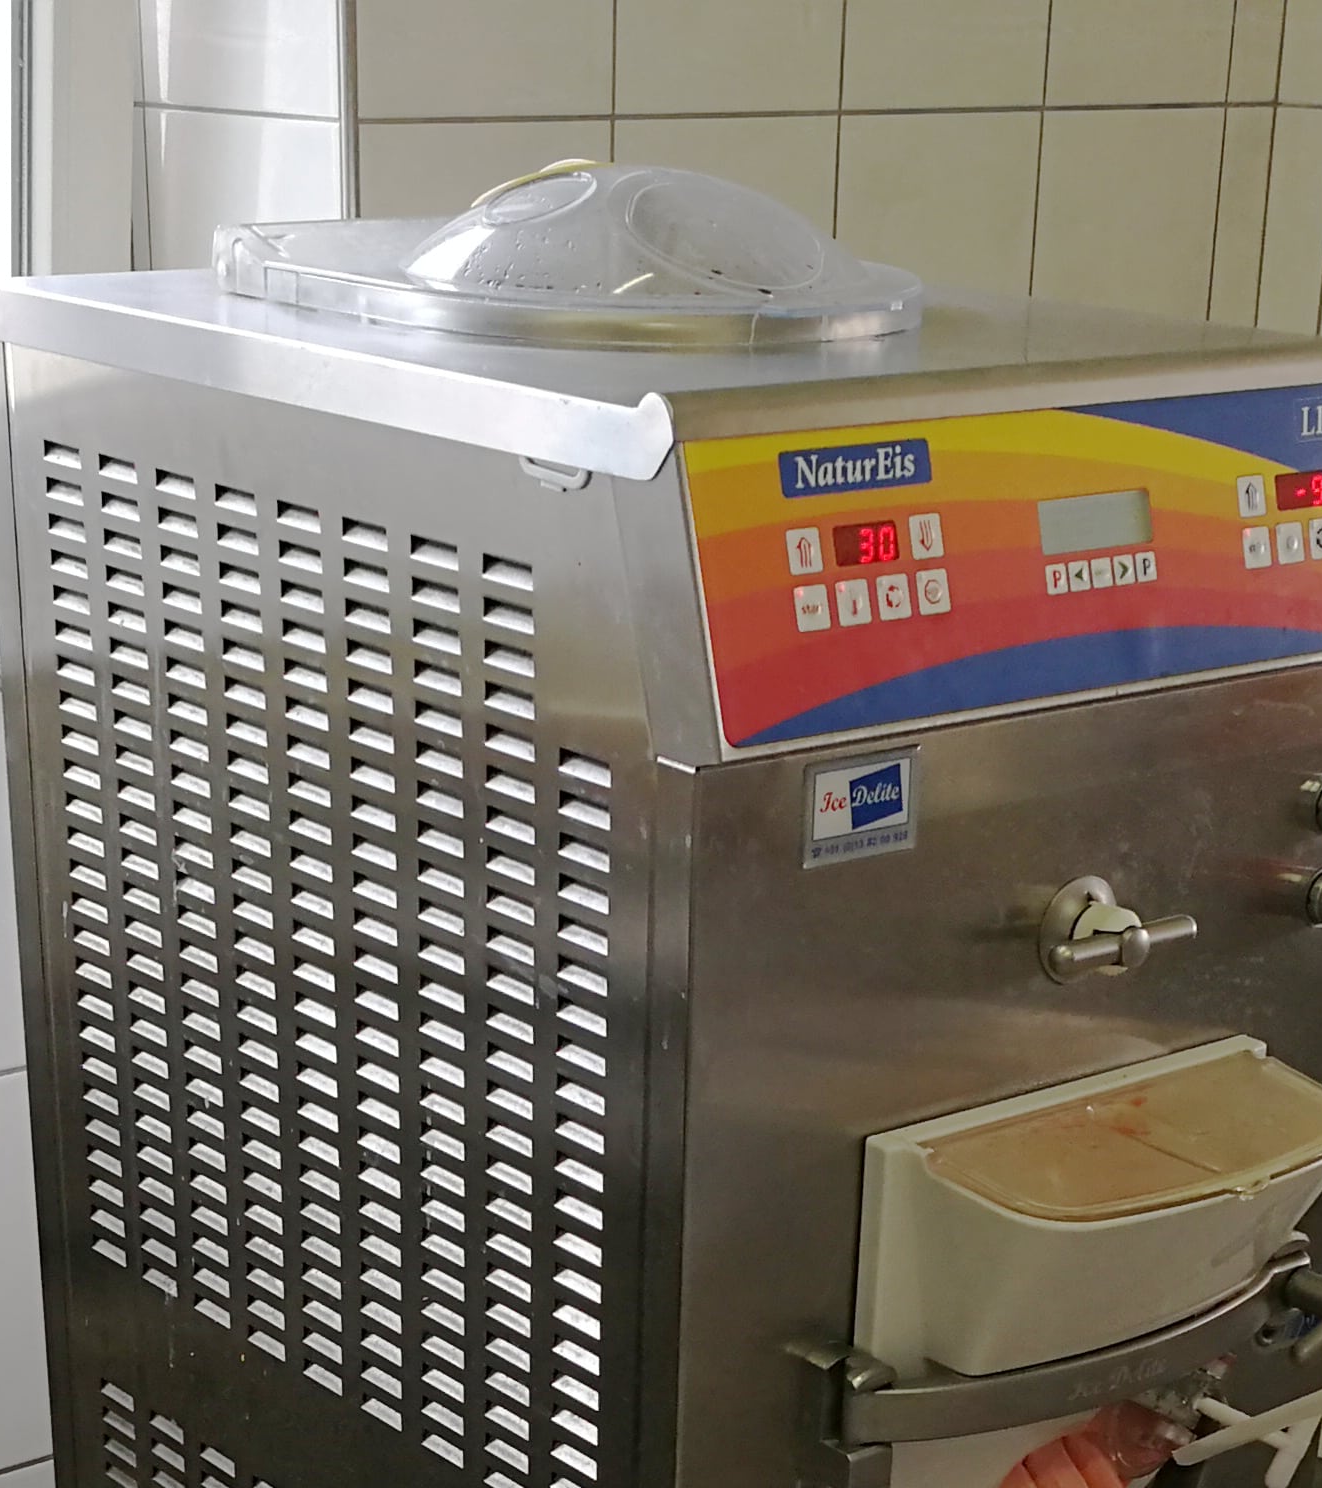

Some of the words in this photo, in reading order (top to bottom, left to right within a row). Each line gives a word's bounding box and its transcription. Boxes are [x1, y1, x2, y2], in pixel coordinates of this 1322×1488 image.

[794, 444, 916, 489] NaturEis
[859, 524, 895, 565] 30
[819, 791, 848, 814] Ice
[851, 781, 900, 808] Delite
